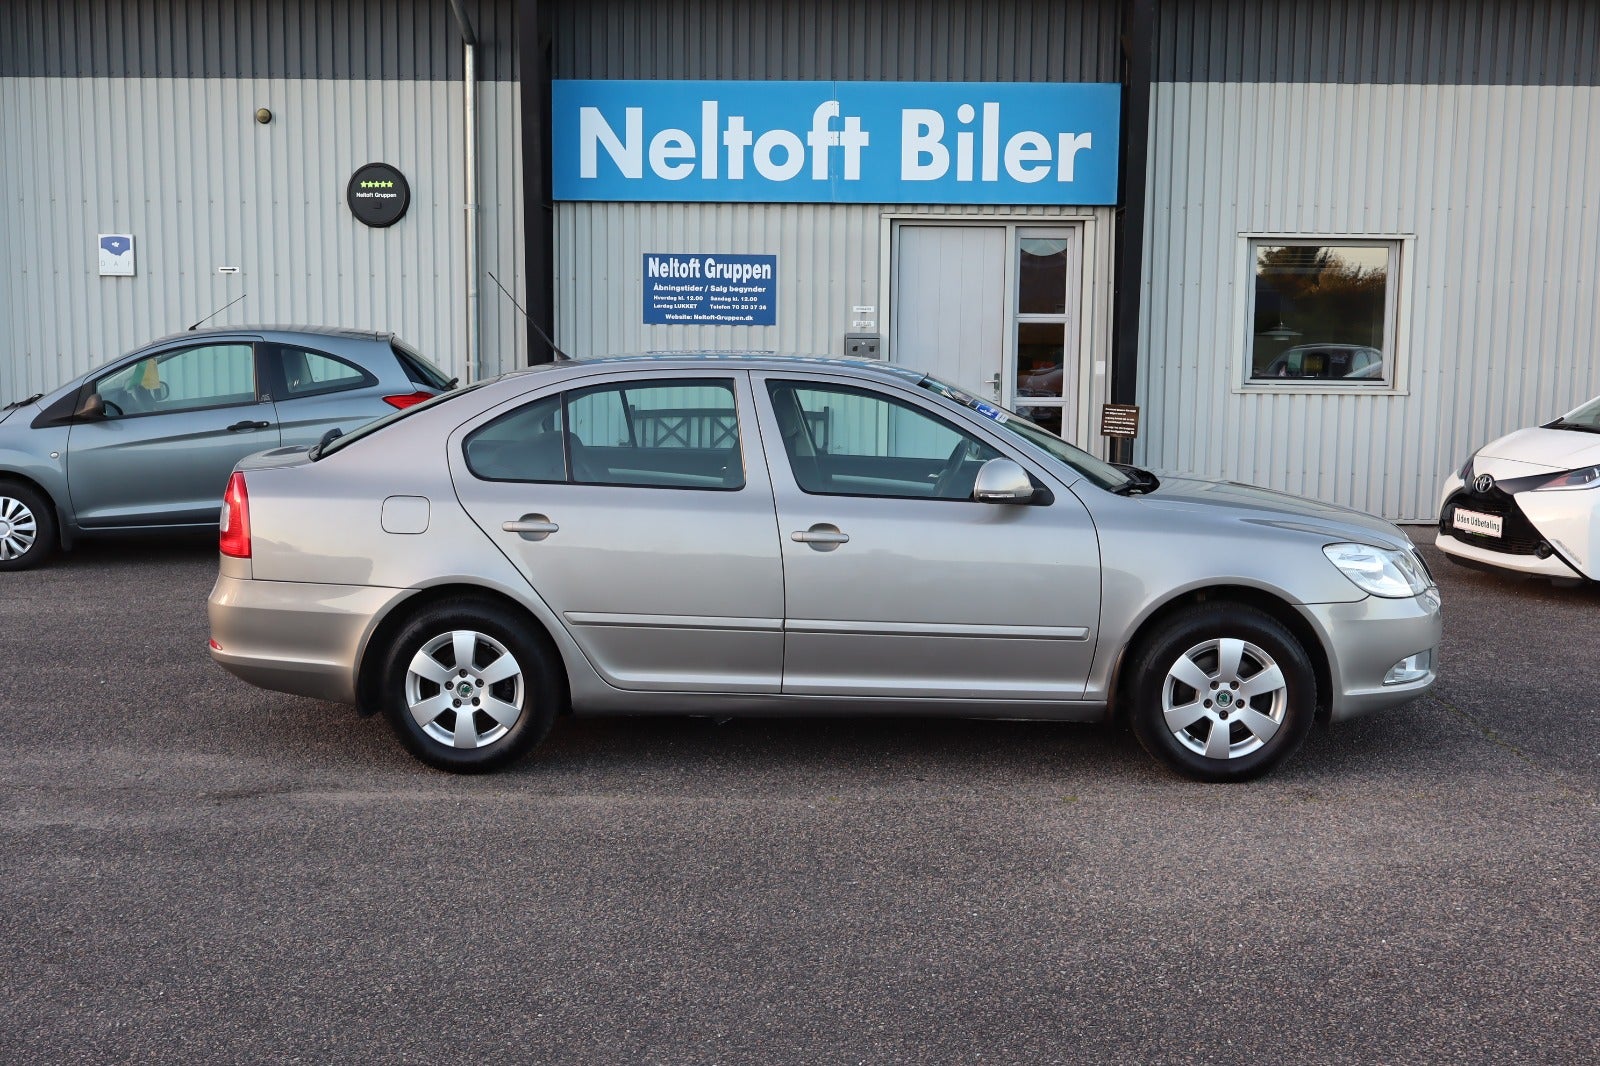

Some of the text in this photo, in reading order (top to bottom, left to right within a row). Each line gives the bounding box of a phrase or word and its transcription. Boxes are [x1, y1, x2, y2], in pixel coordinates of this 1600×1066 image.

[579, 100, 1092, 183] Neltoft Biler
[648, 257, 772, 283] Neltoft Gruppen
[653, 282, 704, 293] Åbningstider
[710, 285, 727, 293] Salg
[729, 285, 766, 293] begynder
[1456, 513, 1500, 532] Uden Udbetaling
